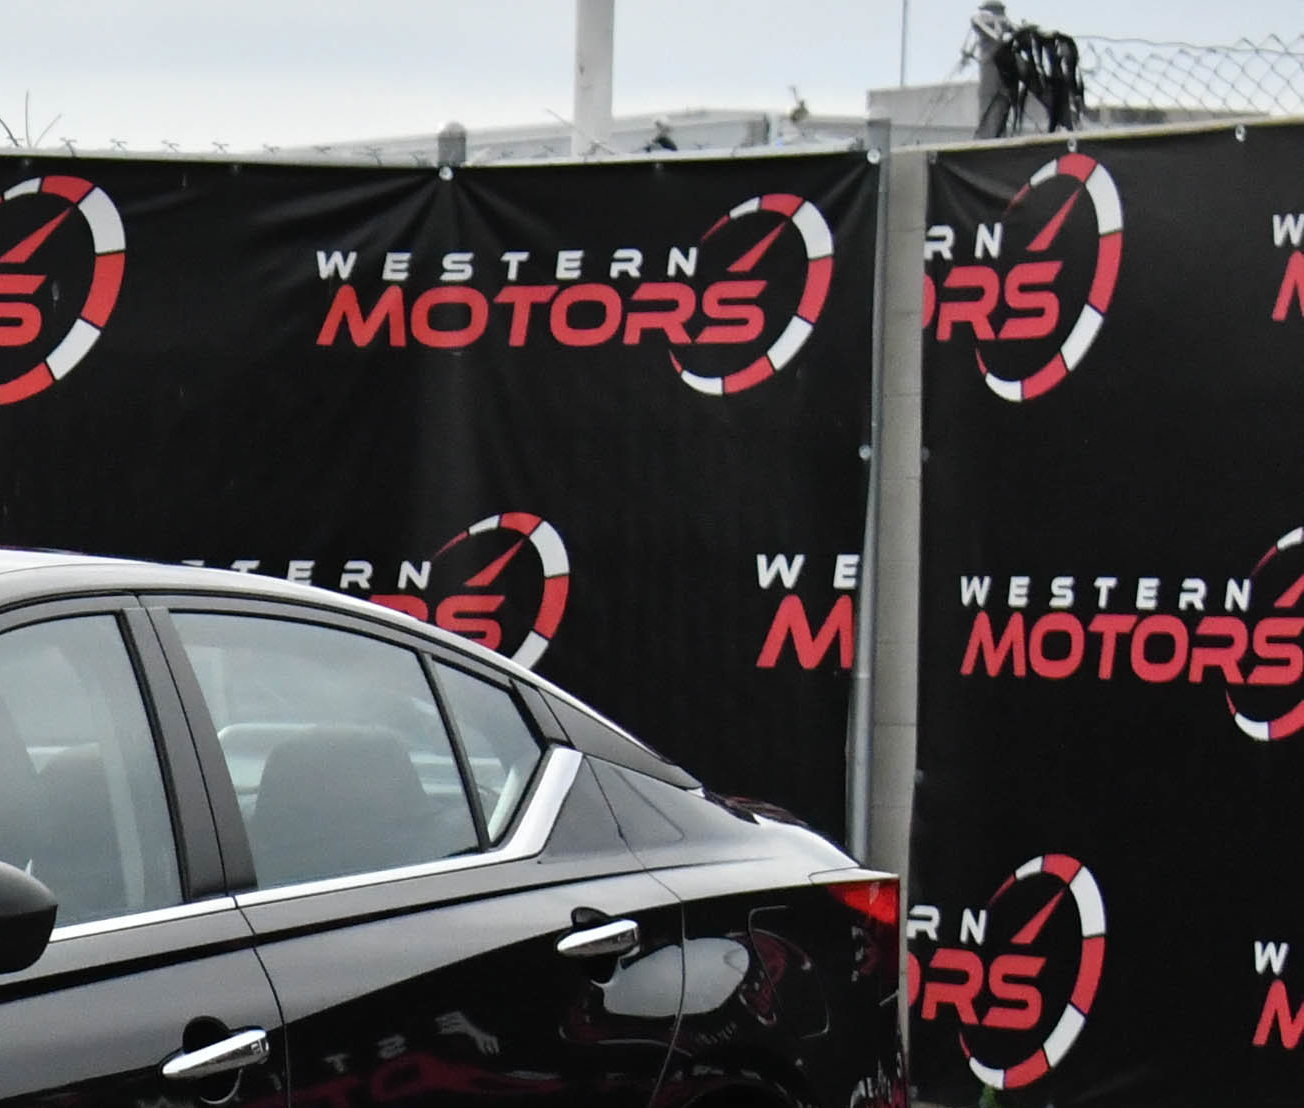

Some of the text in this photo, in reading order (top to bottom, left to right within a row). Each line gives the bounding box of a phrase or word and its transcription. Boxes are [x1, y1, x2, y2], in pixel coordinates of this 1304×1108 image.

[317, 248, 697, 280] WESTERN
[318, 280, 766, 347] MOTORS
[961, 577, 1250, 610] WESTERN
[961, 612, 1304, 684] MOTORS
